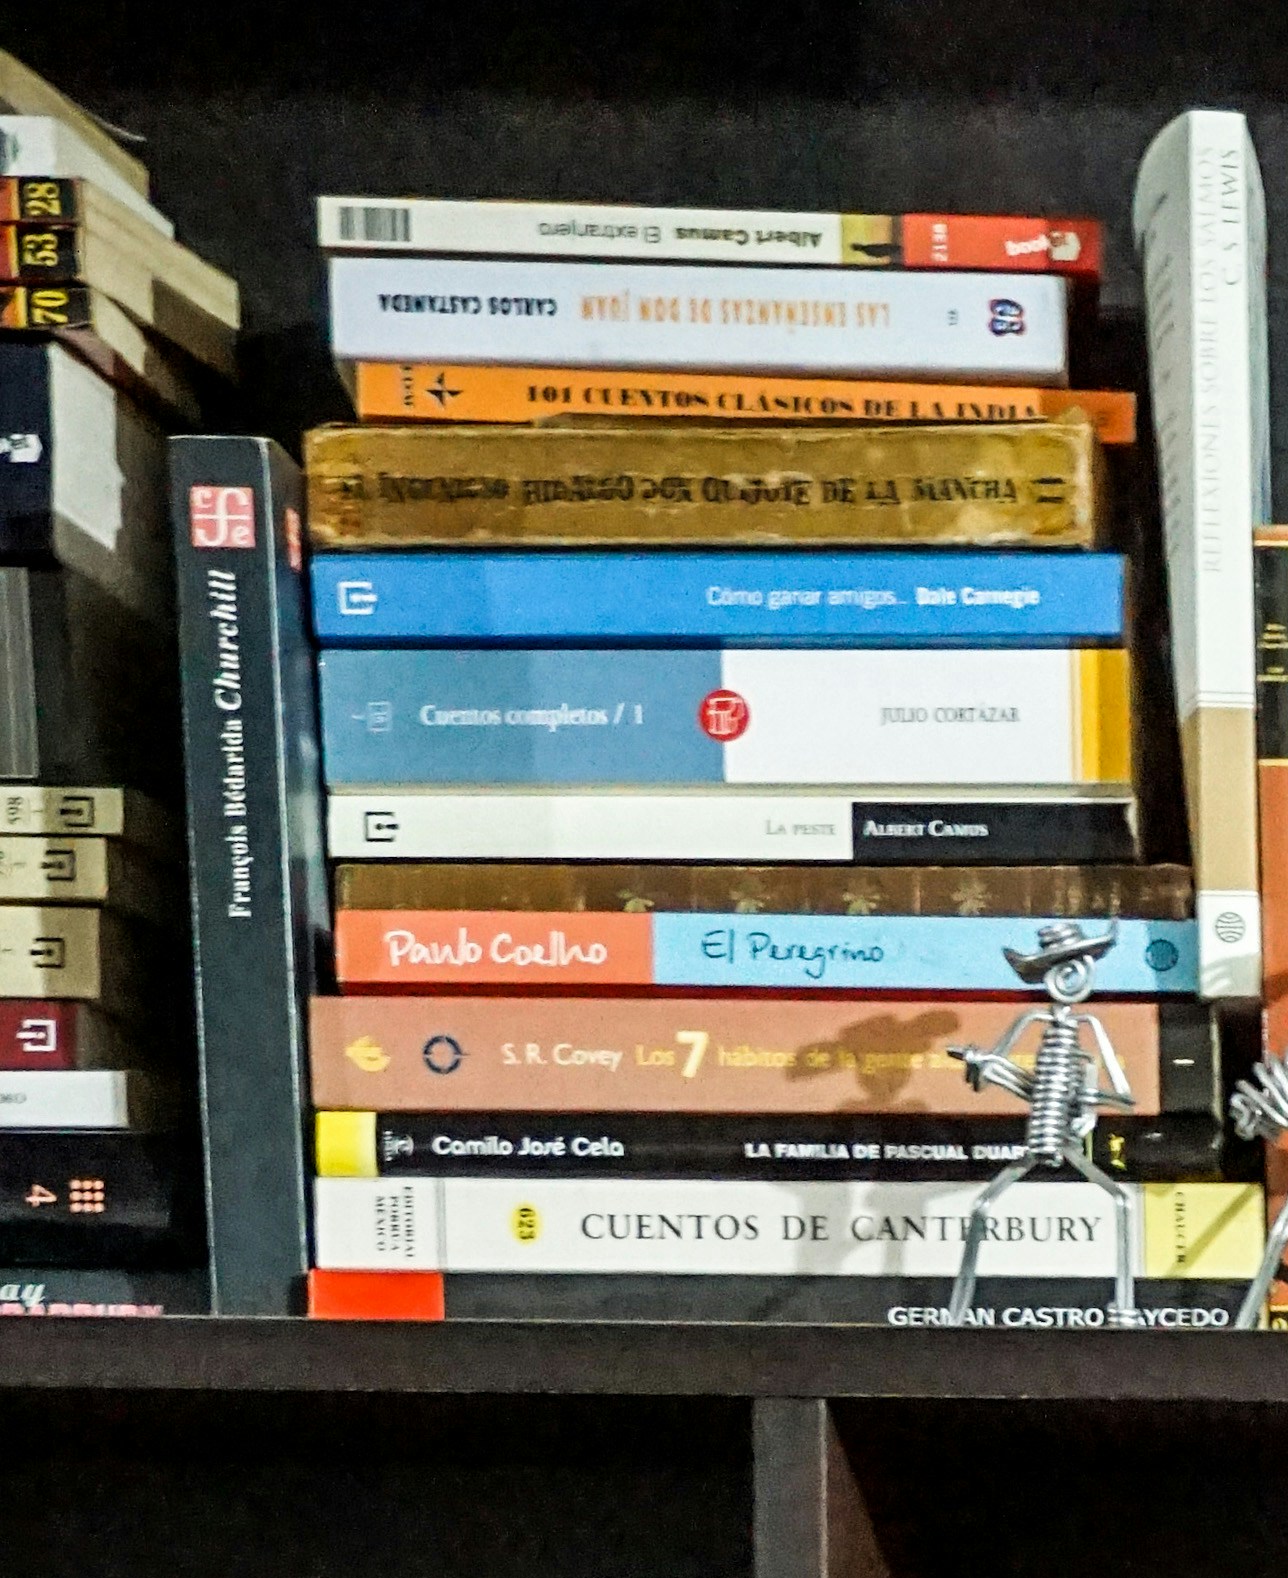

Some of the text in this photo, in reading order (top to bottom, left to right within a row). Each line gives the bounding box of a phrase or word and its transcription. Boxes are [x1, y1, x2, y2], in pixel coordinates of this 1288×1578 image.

[488, 296, 557, 317] CARLOS
[916, 585, 1042, 610] Dale Carnegie
[881, 707, 929, 725] JULIO
[207, 569, 252, 920] François Bédarida Churchill
[383, 927, 607, 967] Paulo Coelho
[700, 928, 885, 970] El Peregrino
[431, 1135, 625, 1157] Camilo José Cela
[581, 1213, 759, 1241] CUENTOS
[782, 1214, 830, 1242] DE
